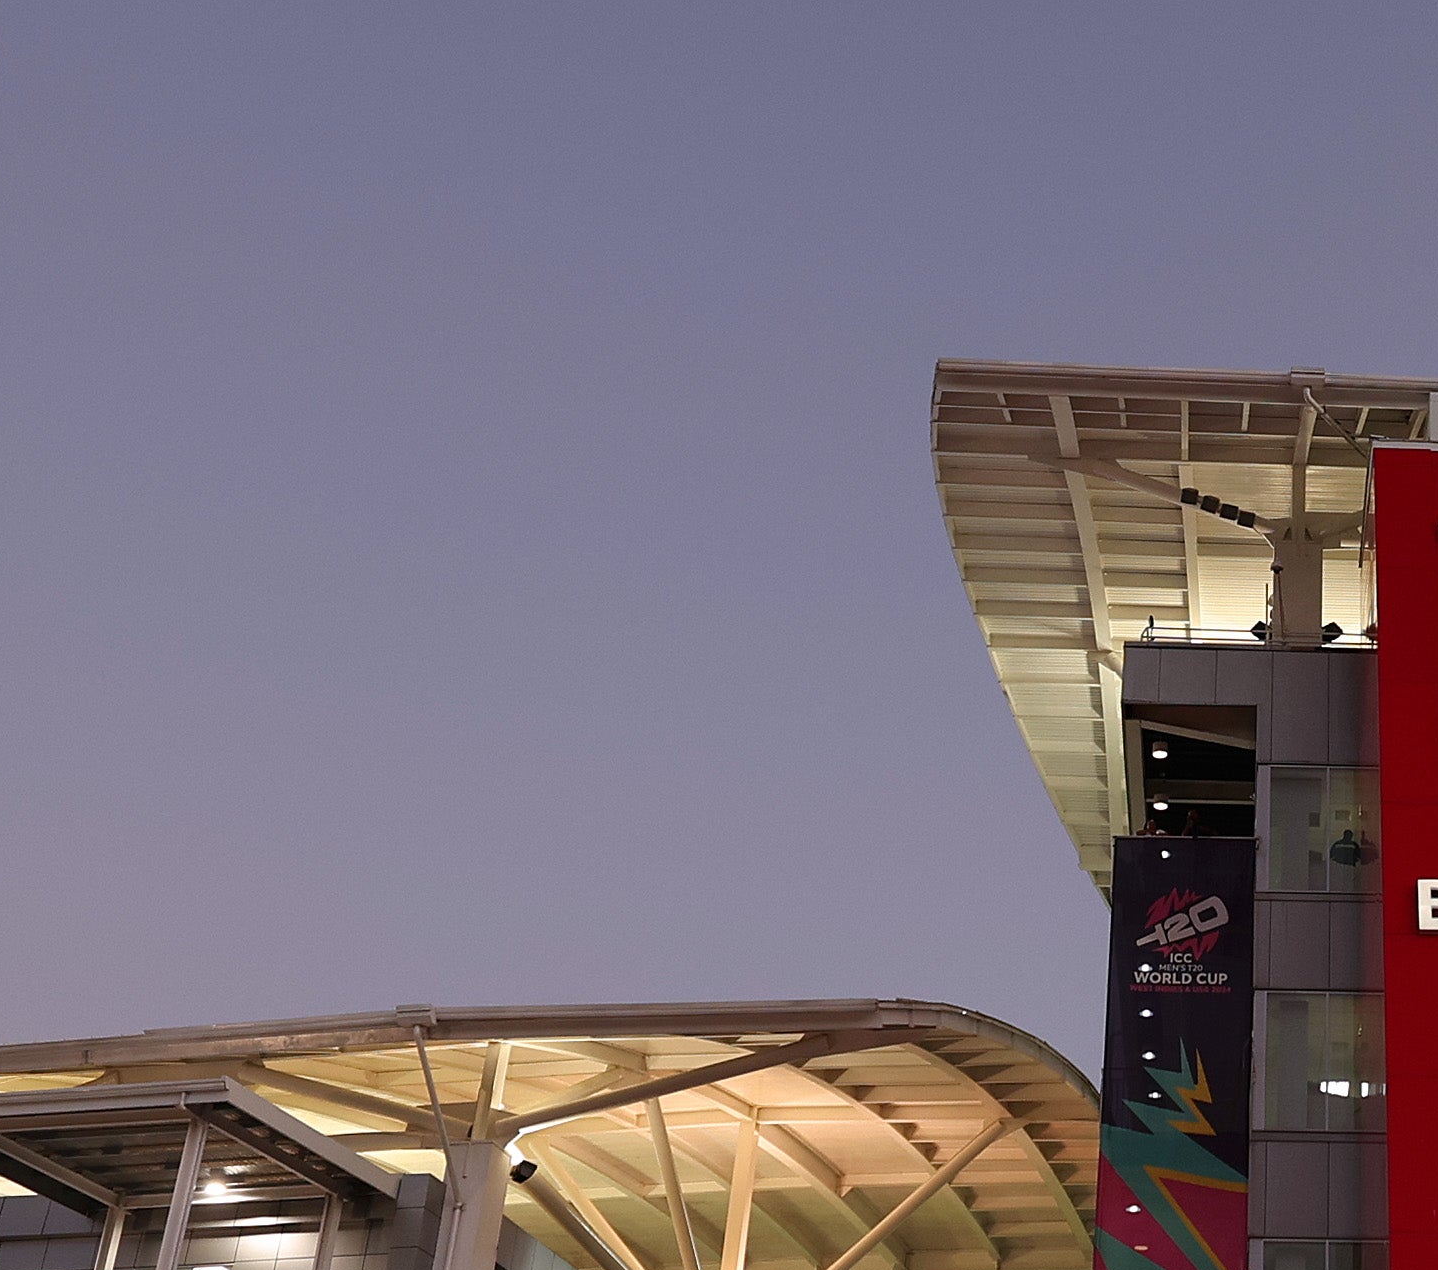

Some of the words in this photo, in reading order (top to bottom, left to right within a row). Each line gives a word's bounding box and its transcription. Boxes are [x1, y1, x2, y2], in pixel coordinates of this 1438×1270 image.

[1136, 895, 1229, 947] T20
[1170, 953, 1193, 963] ICC
[1133, 971, 1193, 985] WORLD
[1196, 972, 1228, 985] CUP
